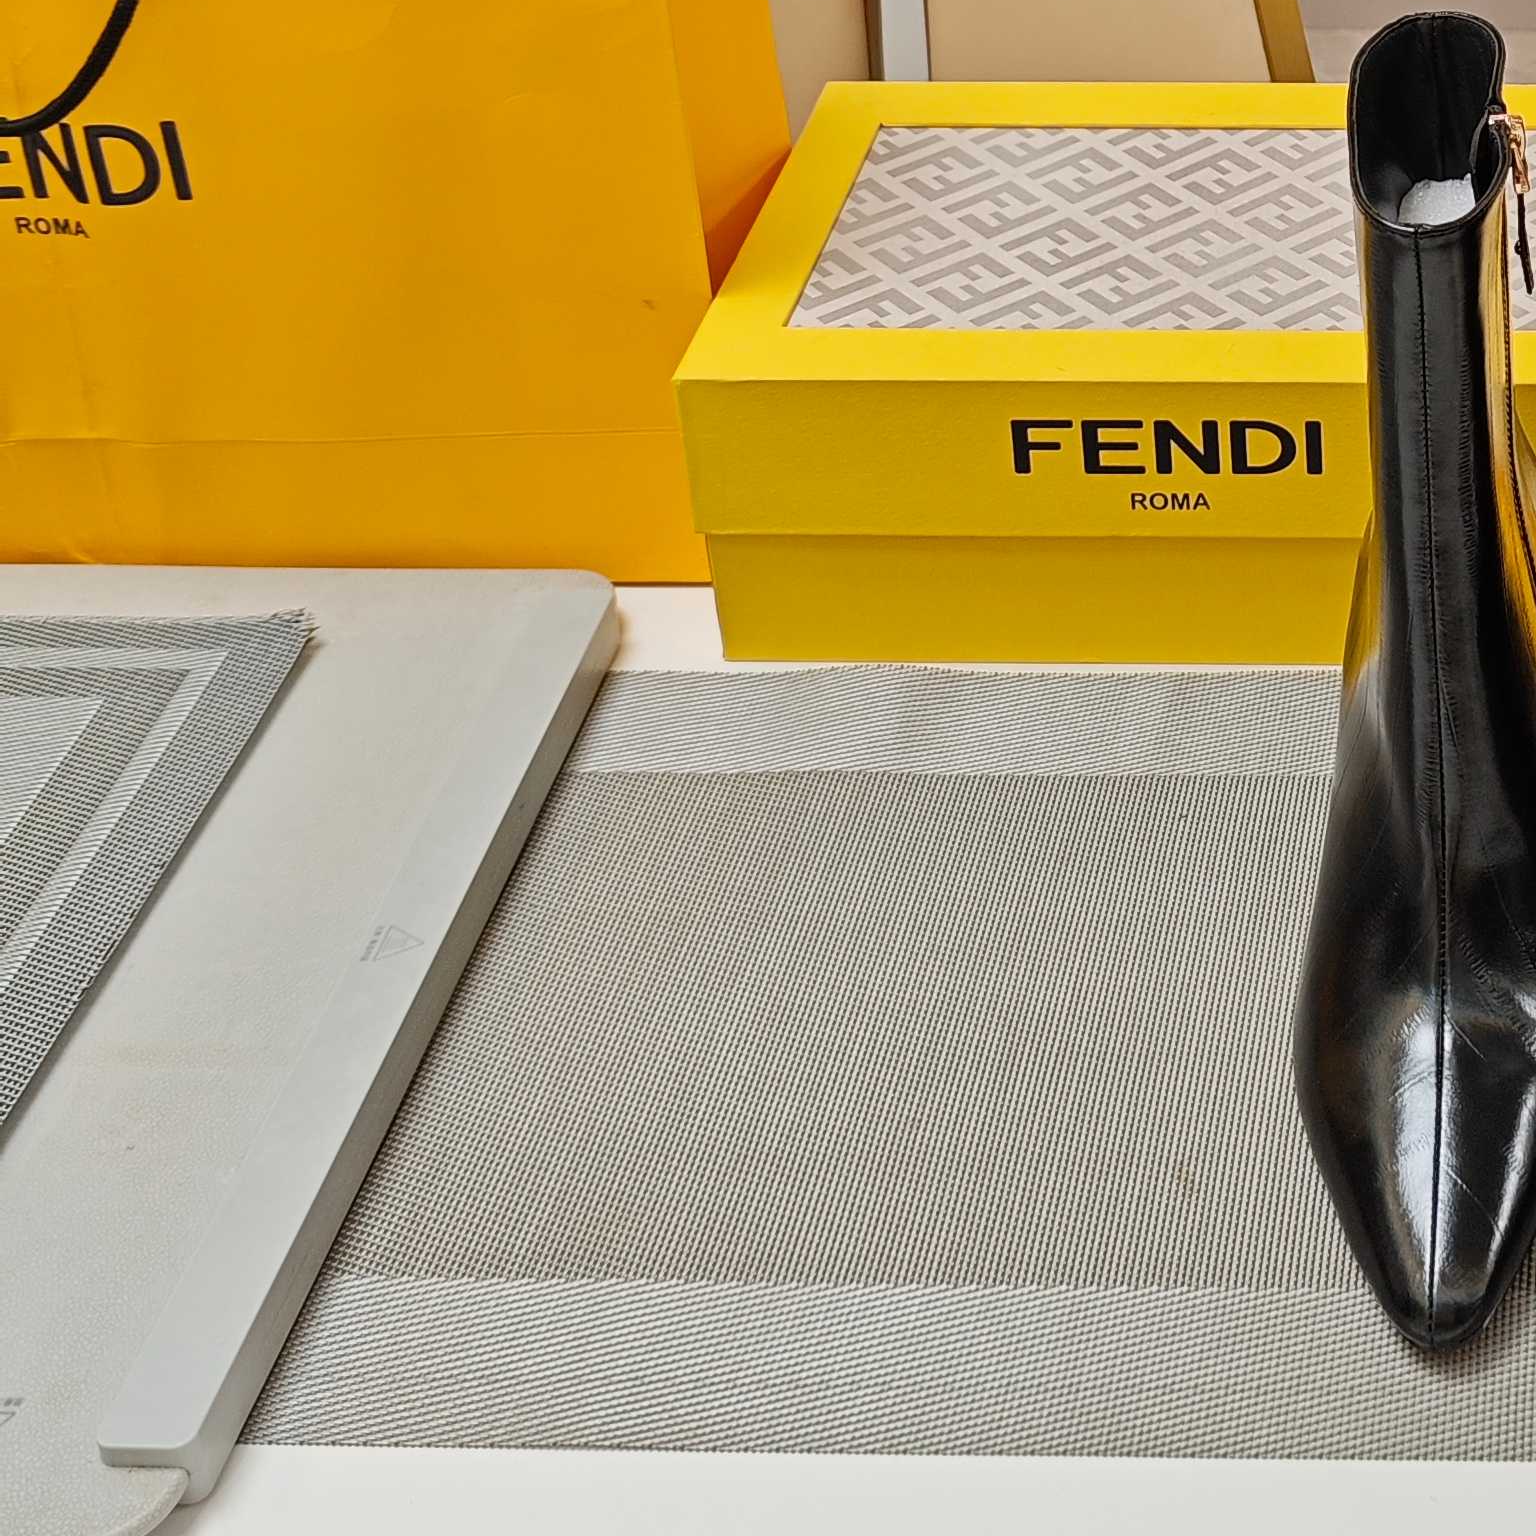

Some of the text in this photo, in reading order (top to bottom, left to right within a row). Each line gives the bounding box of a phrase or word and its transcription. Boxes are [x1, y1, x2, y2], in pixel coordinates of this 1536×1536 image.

[14, 216, 91, 239] ROMA
[1010, 419, 1324, 475] FENDI
[1130, 492, 1211, 511] ROMA
